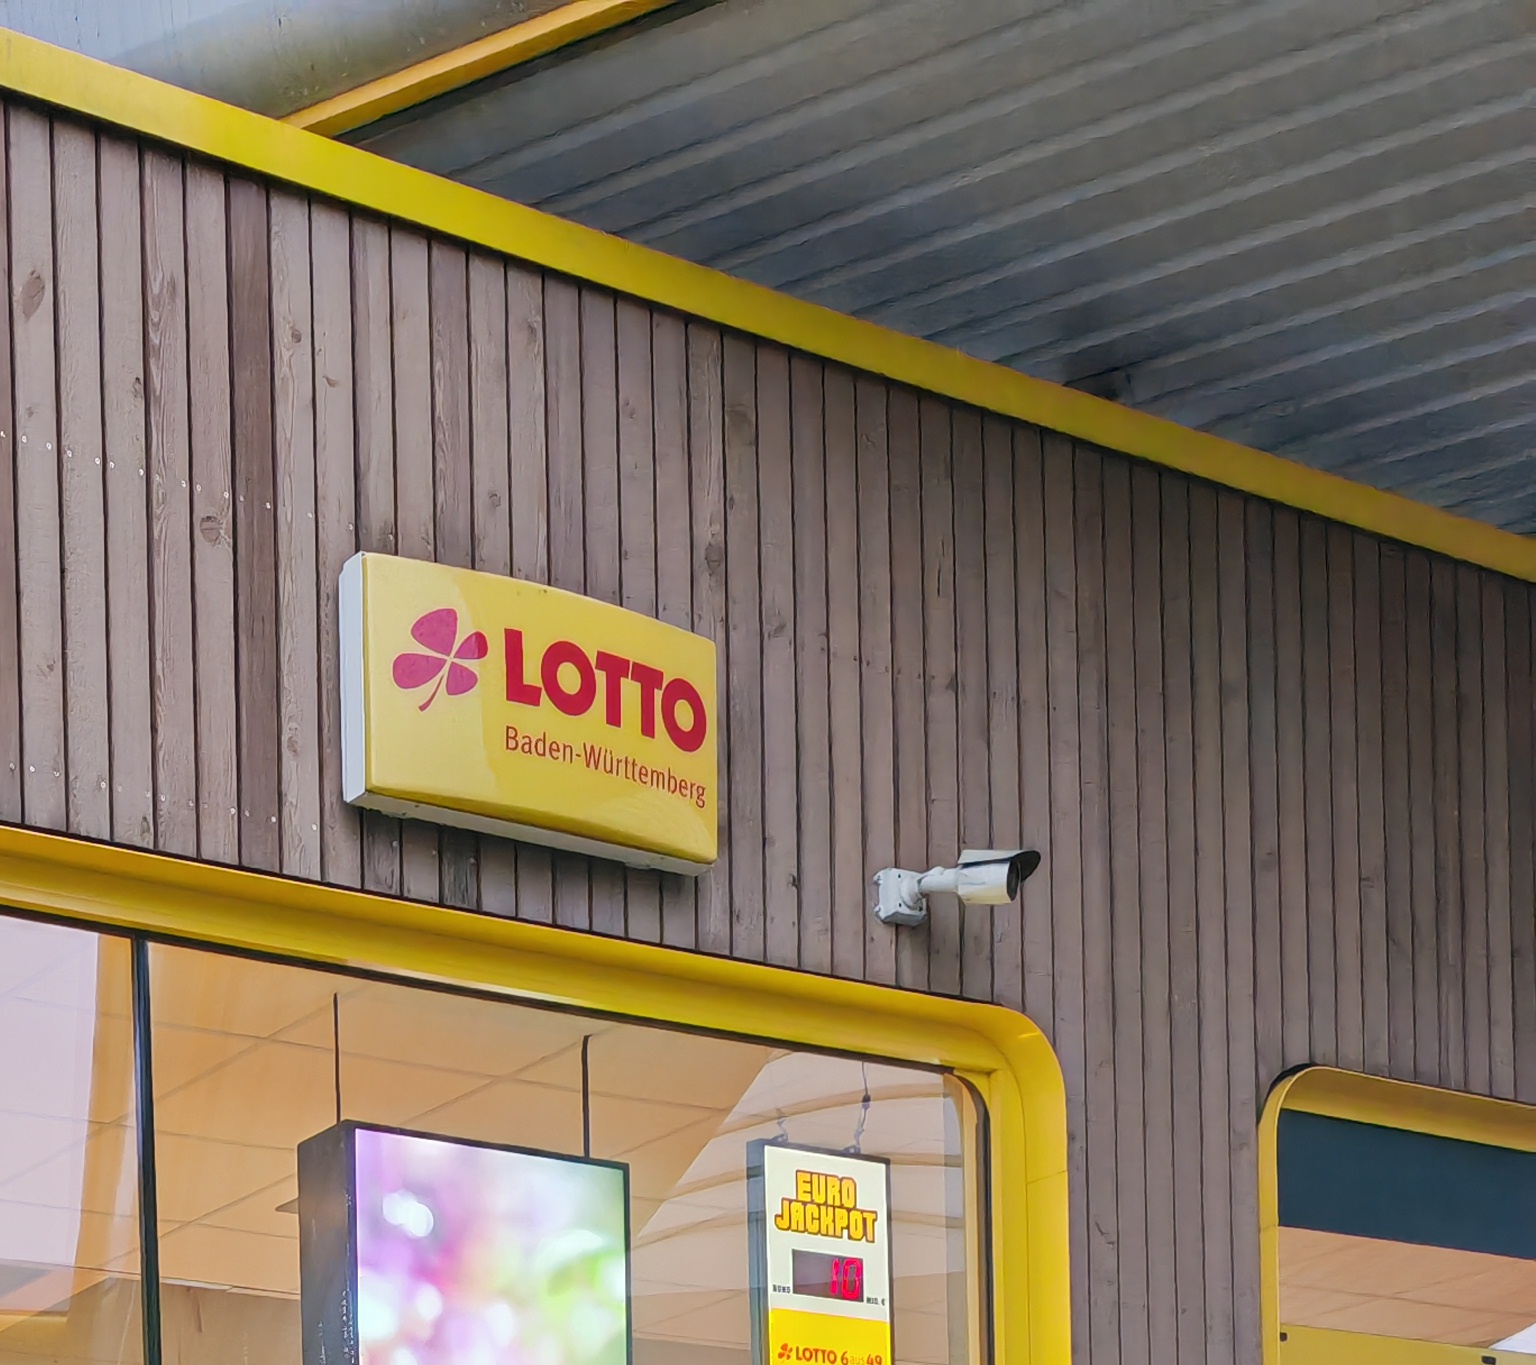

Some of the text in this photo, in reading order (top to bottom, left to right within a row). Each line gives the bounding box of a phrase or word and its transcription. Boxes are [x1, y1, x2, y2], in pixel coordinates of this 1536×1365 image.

[504, 628, 707, 753] LOTTO
[505, 726, 707, 809] Baden-Württemberg
[796, 1169, 857, 1208] EURO
[774, 1197, 878, 1243] JACKPOT
[830, 1258, 863, 1300] 10
[796, 1346, 837, 1364] LOTTO
